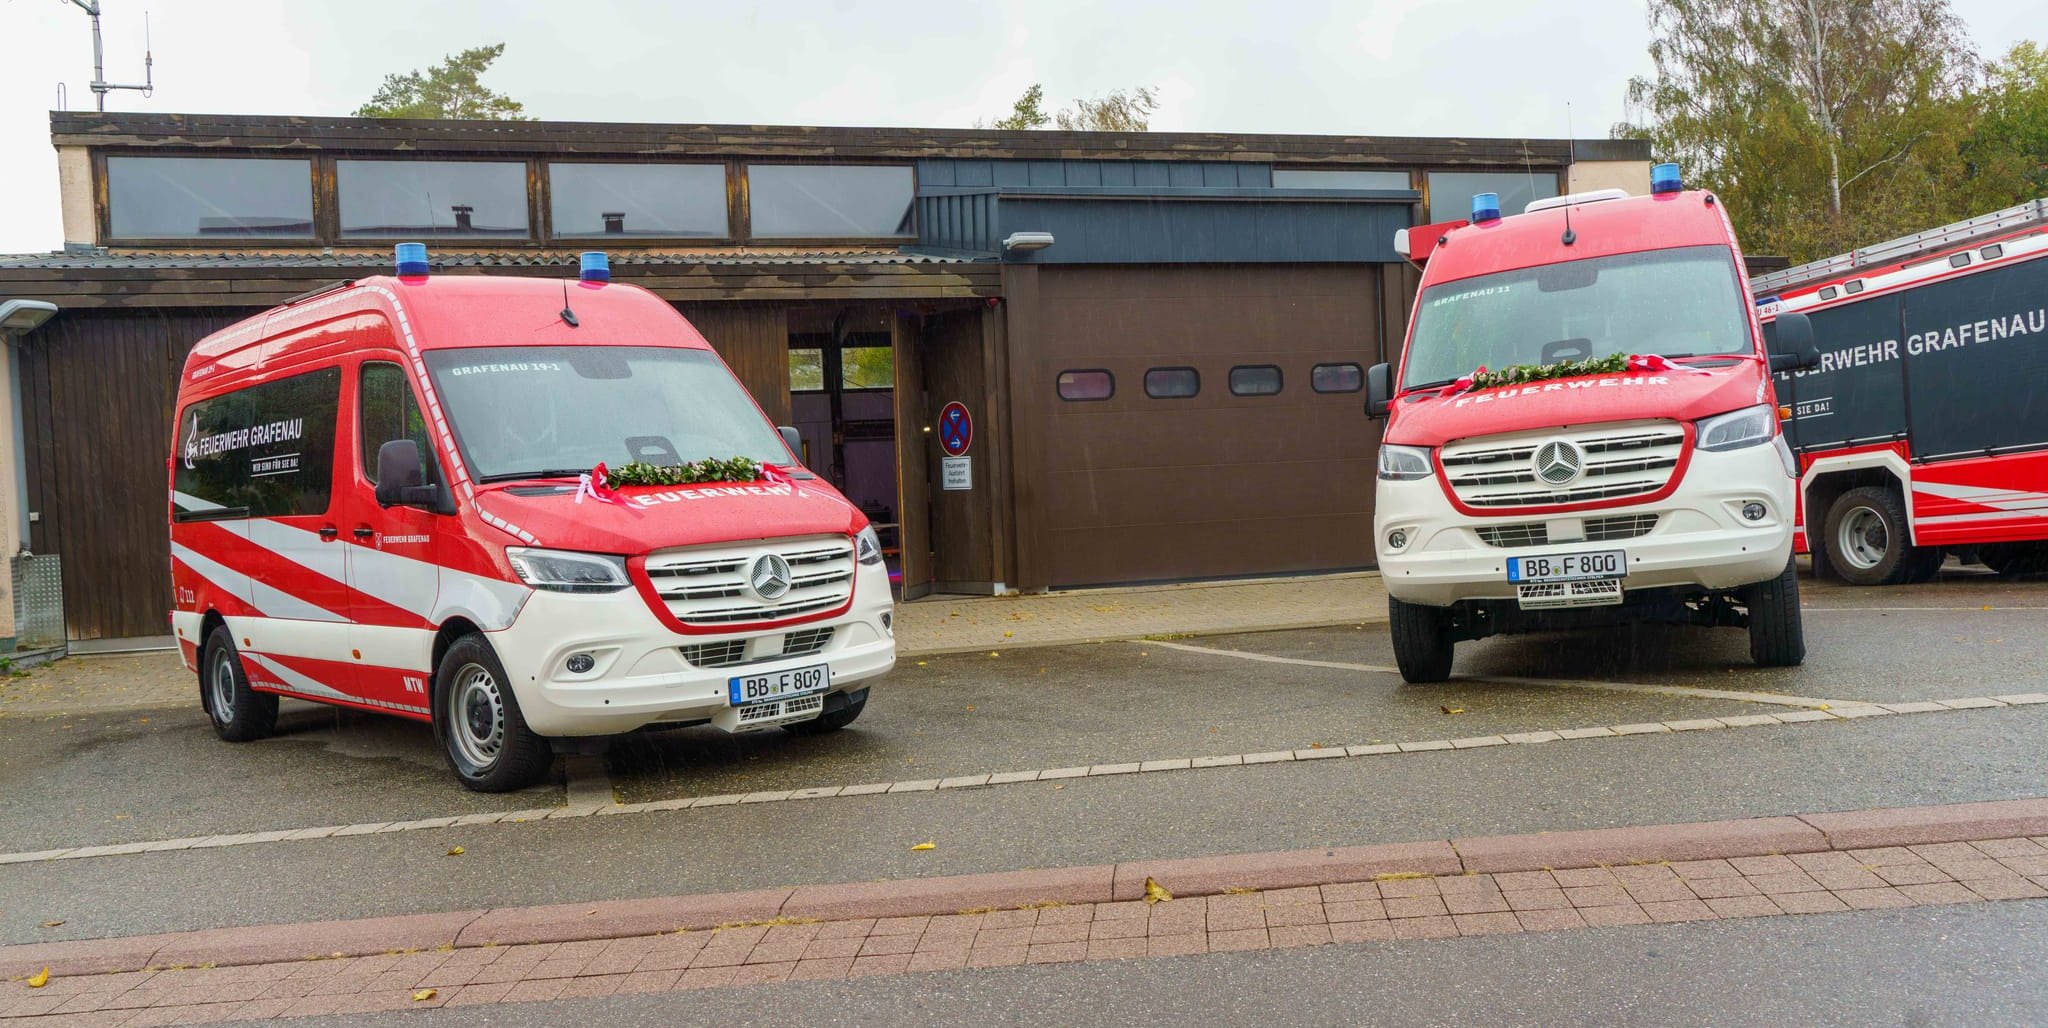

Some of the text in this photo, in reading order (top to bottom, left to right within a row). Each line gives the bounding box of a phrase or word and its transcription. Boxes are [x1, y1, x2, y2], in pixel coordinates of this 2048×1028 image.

[1433, 287, 1495, 307] GRAFENAU
[1907, 309, 2046, 356] GRAFENAU
[452, 363, 561, 376] GRAFENAU 19-1
[1456, 376, 1670, 409] FEUERWEHR
[1796, 404, 1812, 416] SIE
[1814, 401, 1831, 413] DA!
[199, 417, 303, 457] FEUERWEHR GRAFENAU
[1525, 559, 1551, 577] BB
[1563, 557, 1576, 575] F
[1580, 554, 1617, 574] 800
[402, 676, 425, 694] MTW
[746, 677, 770, 698] BB
[780, 674, 791, 693] F
[793, 669, 822, 690] 809
